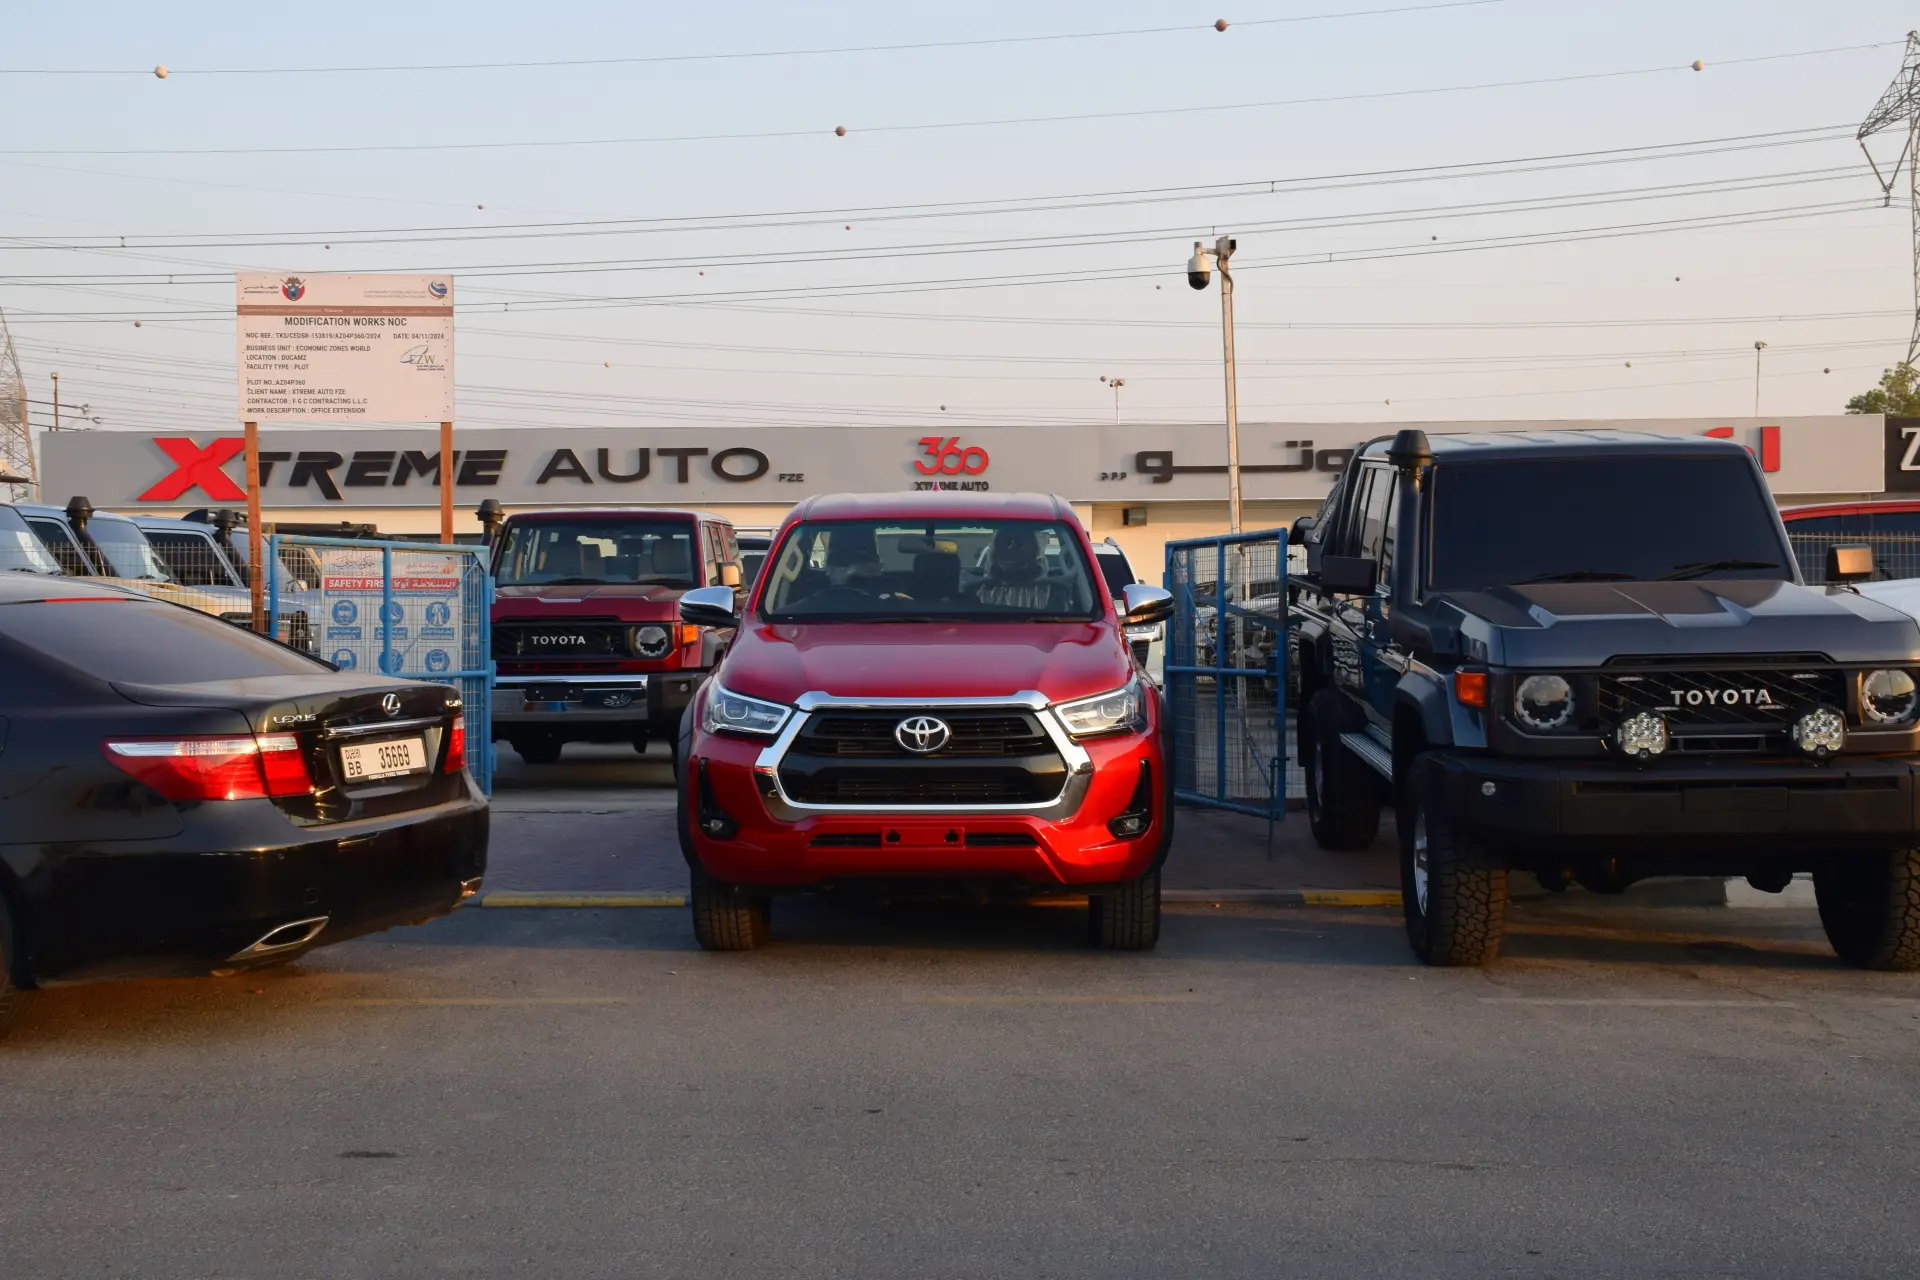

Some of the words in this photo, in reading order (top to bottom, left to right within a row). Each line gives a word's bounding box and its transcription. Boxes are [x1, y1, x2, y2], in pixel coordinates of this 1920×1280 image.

[285, 317, 350, 325] MODIFICATION
[353, 318, 385, 326] WORKS
[388, 318, 407, 326] NOC
[914, 437, 989, 475] 360
[136, 438, 508, 501] XTREME
[536, 447, 770, 484] AUTO
[778, 473, 804, 482] FZE
[960, 481, 989, 491] AUTO
[329, 580, 362, 588] SAFETY
[532, 636, 586, 644] TOYOTA
[1670, 690, 1772, 705] TOYOTA
[273, 713, 317, 724] LEXUS
[378, 744, 410, 769] 35669
[348, 761, 362, 776] BB
